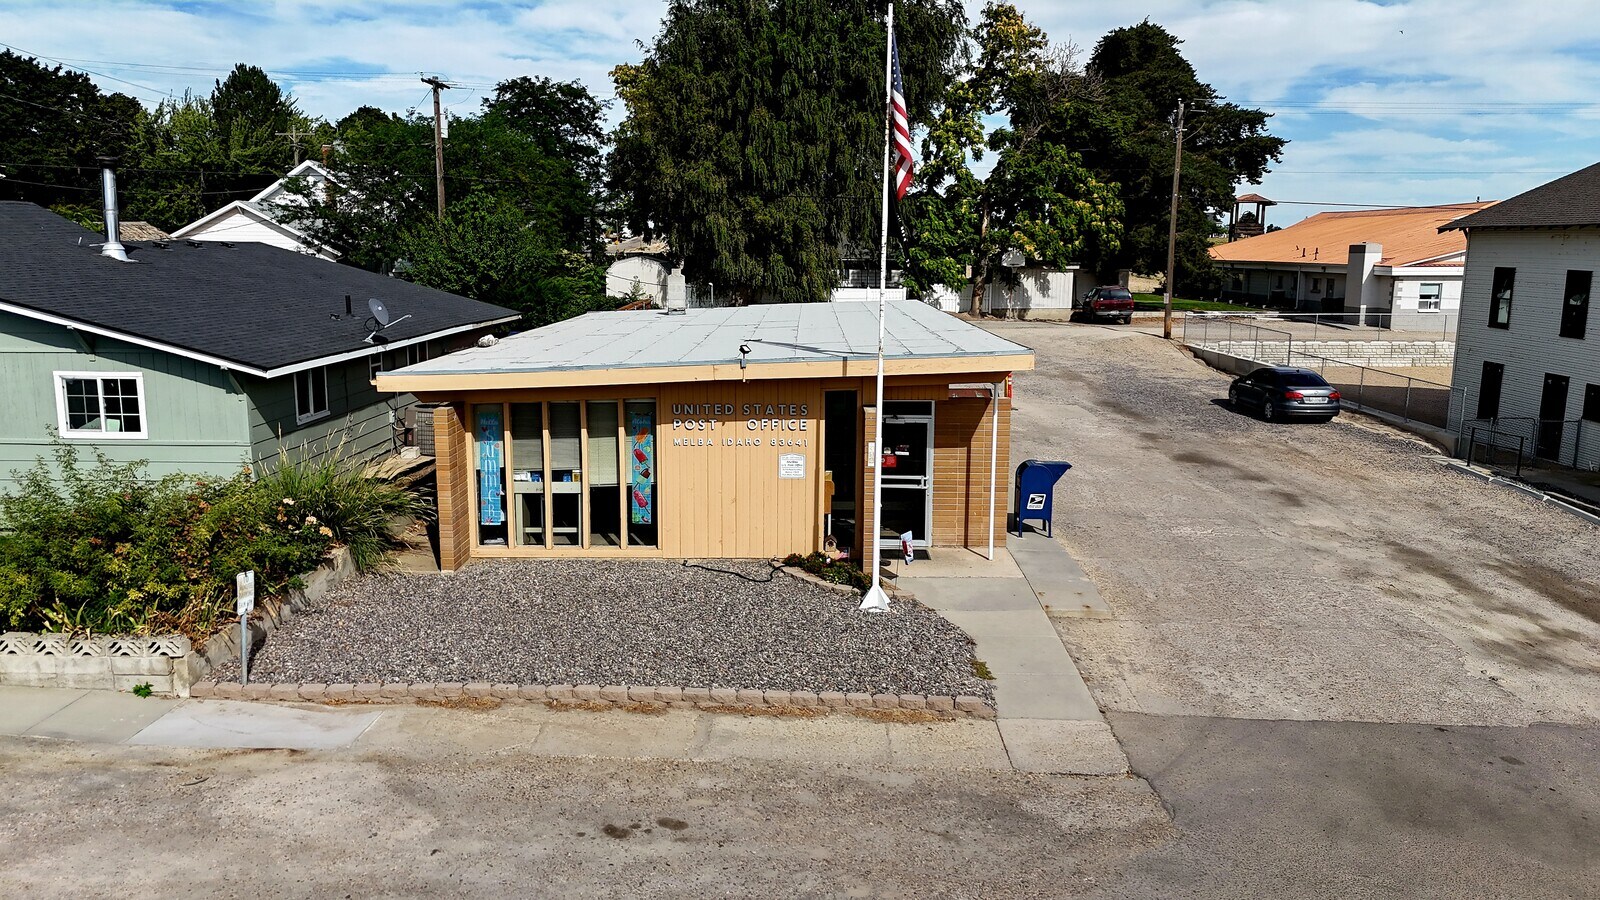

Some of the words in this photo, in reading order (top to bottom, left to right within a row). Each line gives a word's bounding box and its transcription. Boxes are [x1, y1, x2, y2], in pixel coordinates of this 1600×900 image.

[672, 404, 734, 415] UNITED
[743, 404, 808, 416] STATES
[673, 419, 718, 431] POST
[747, 419, 808, 431] OFFICE
[673, 438, 714, 447] MELBA
[722, 438, 762, 447] IDAHO
[769, 438, 809, 447] 83641
